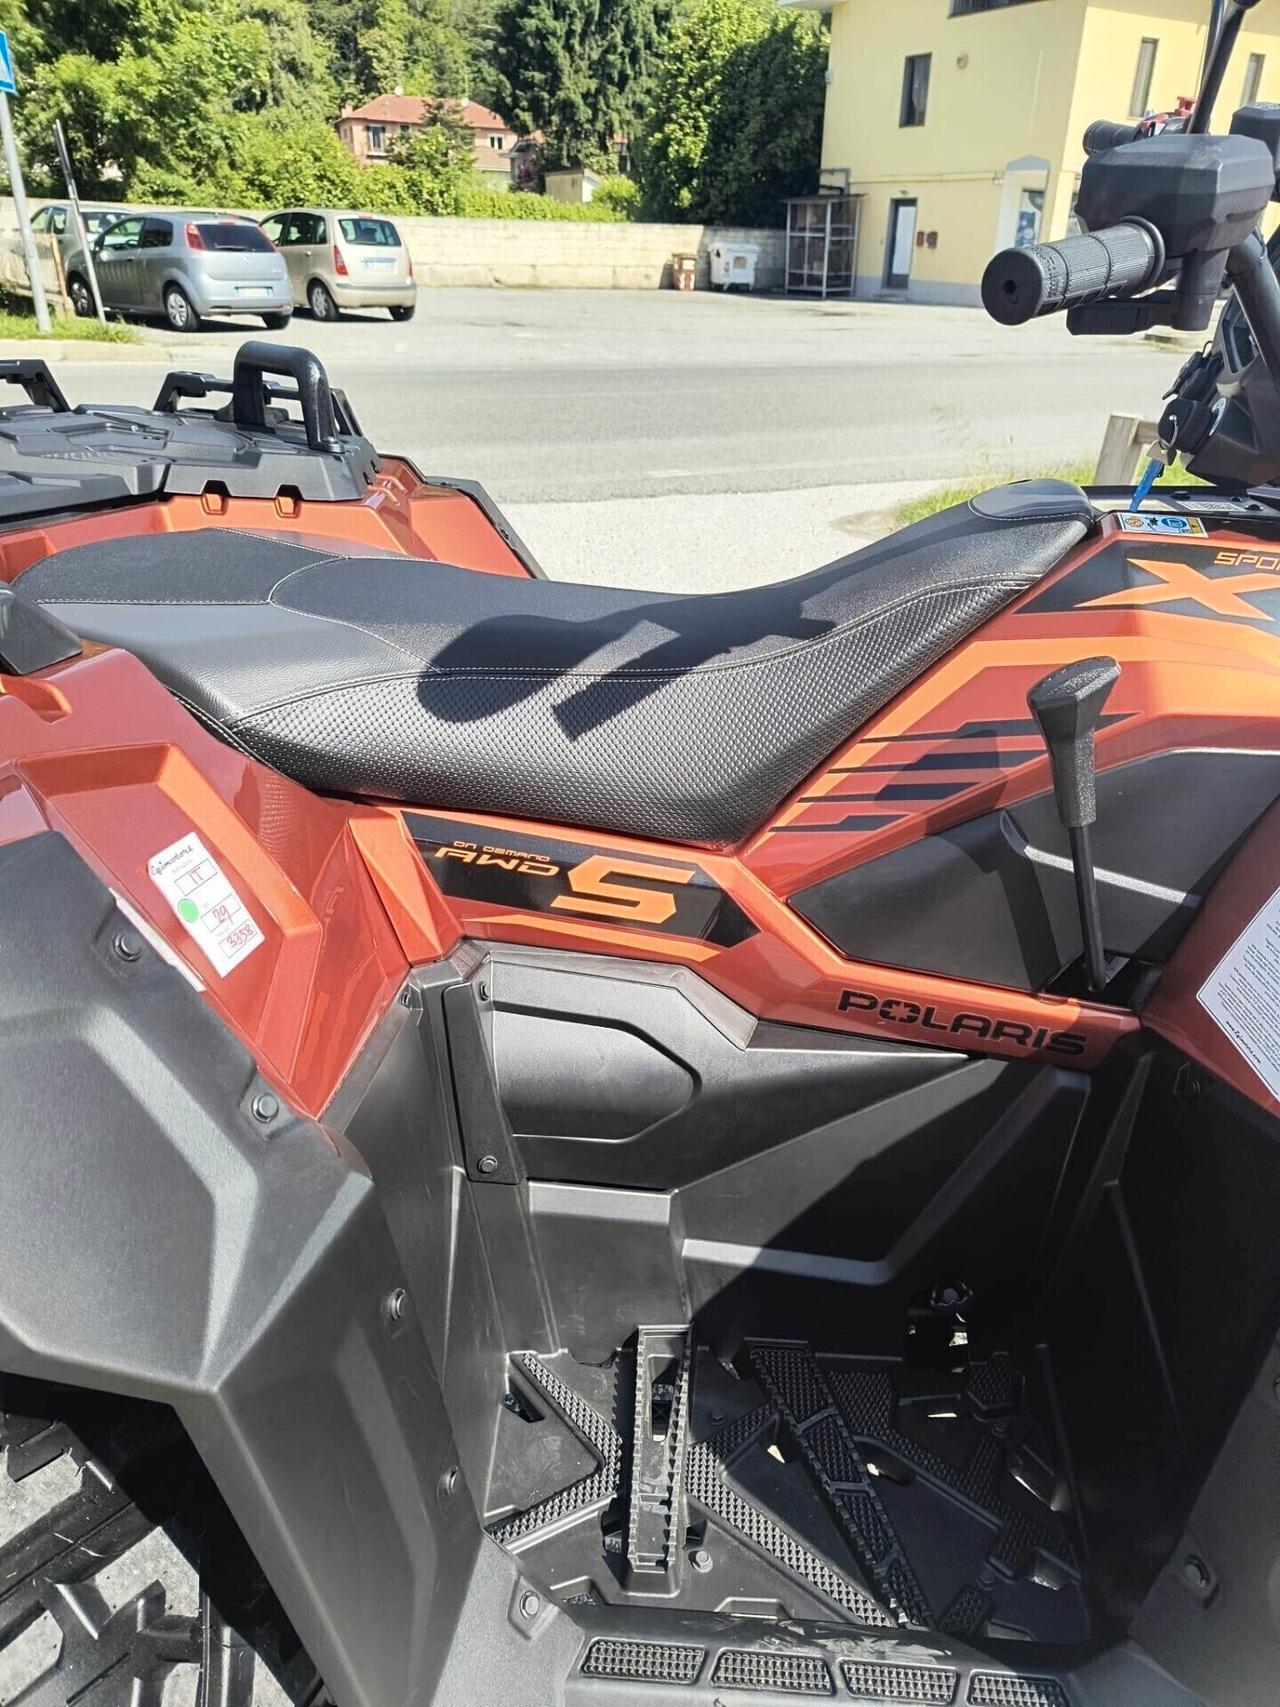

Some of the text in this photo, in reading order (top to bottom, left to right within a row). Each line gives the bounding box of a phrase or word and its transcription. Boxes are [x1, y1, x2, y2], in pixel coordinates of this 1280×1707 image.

[434, 846, 560, 877] AWD
[550, 855, 696, 924] S
[837, 988, 1088, 1056] POLARIS
